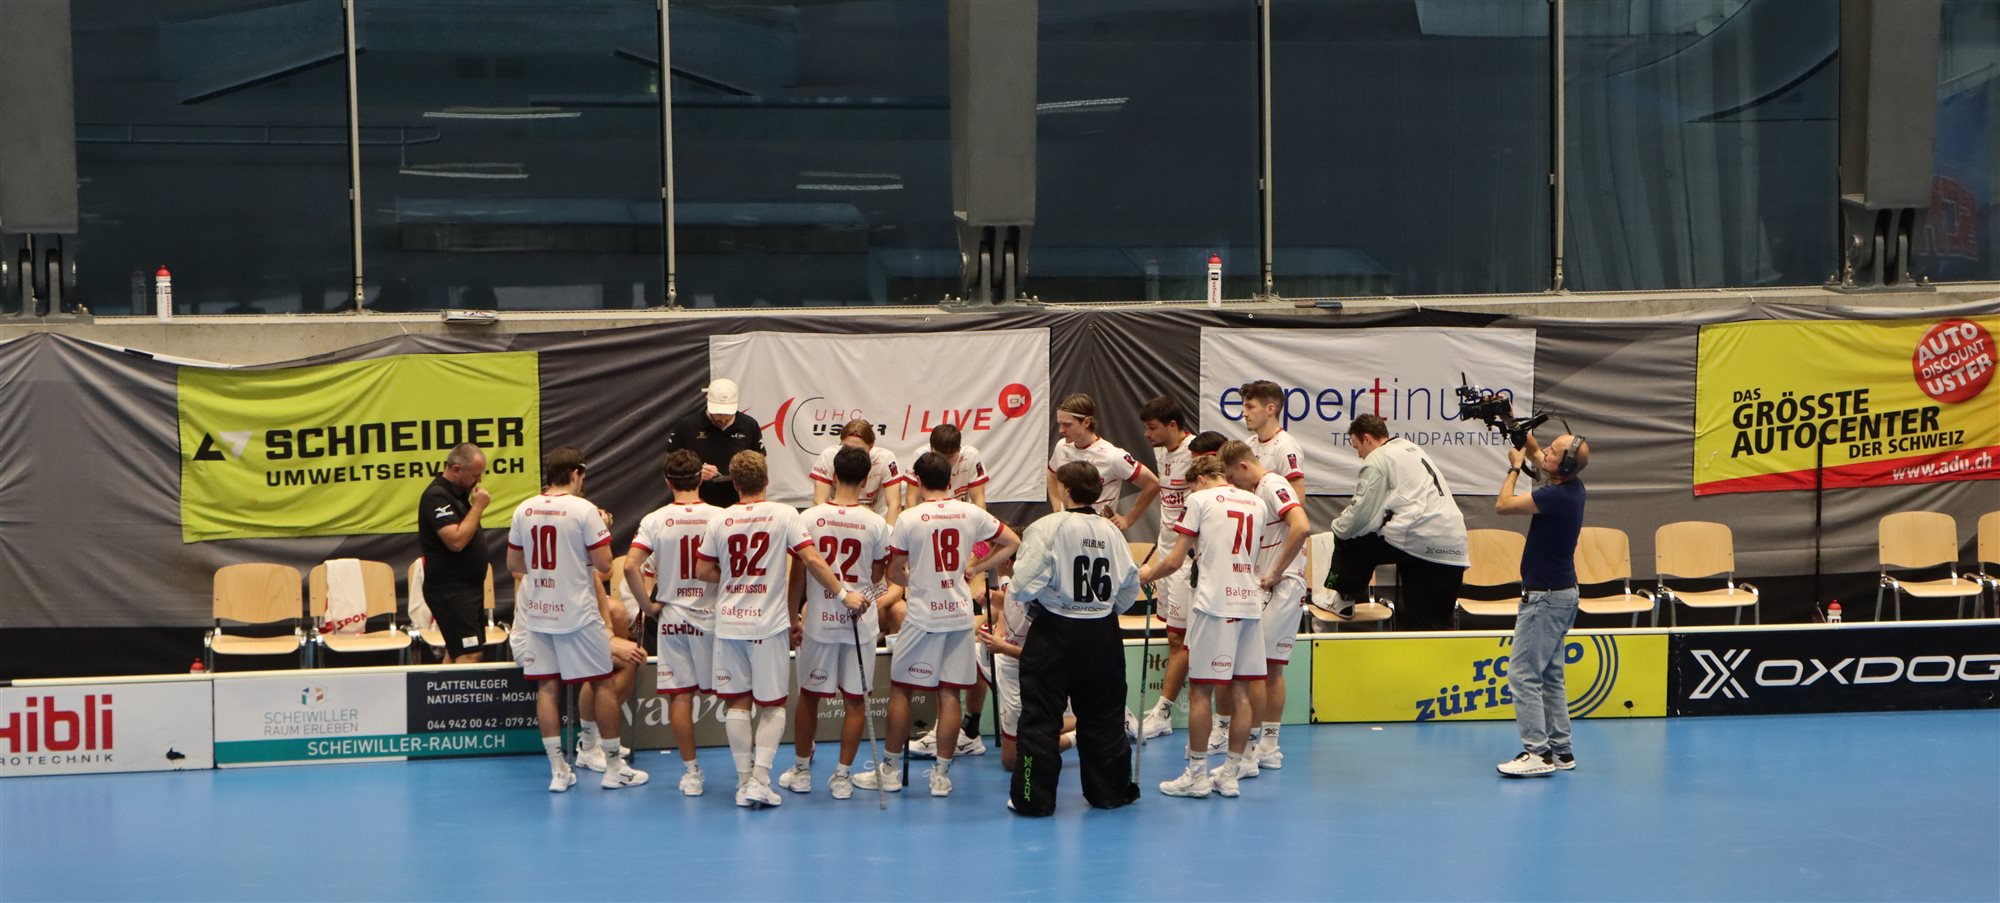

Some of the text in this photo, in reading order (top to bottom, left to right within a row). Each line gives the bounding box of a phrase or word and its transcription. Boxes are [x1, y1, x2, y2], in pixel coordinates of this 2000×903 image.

[1918, 322, 1980, 367] AUTO
[1921, 338, 1985, 379] DISCOUNT
[1925, 352, 1995, 396] USTER
[1219, 377, 1514, 432] epertinu
[1732, 388, 1870, 430] GRÖSSTE
[1733, 388, 1762, 404] DAS
[812, 423, 887, 436] USR
[814, 407, 994, 433] UHC LIVE
[1730, 405, 1941, 458] AUTOCENTER
[265, 416, 525, 460] SCHNEIDER
[1848, 429, 1965, 460] DER SCHWEIZ
[266, 457, 525, 488] UMWELTSERV.CH
[1892, 452, 1993, 481] www.adu.ch
[530, 525, 557, 570] 10
[1226, 509, 1254, 557] 71
[727, 531, 770, 578] 82
[819, 535, 862, 584] 22
[931, 528, 960, 573] 18
[677, 587, 704, 598] PFISTER
[1073, 555, 1112, 603] 66
[1225, 586, 1258, 599] Balgris
[528, 600, 565, 613] Balgrist
[721, 606, 763, 618] Balgrist
[822, 611, 863, 624] Balgrt
[930, 599, 969, 613] Balgrst
[426, 679, 509, 691] PLATTENLEGER
[1755, 654, 2000, 687] OXDOG
[426, 693, 493, 705] NATURSTEIN
[264, 708, 359, 725] SCHEIWILLER
[264, 722, 359, 737] RAUM ERLEBEN
[427, 720, 446, 730] 044
[448, 719, 467, 729] 942
[469, 718, 482, 728] 00
[484, 718, 497, 728] 42
[505, 717, 524, 727] 079
[526, 716, 539, 726] 24
[307, 734, 506, 757] SCHEIWILLER-RAUM.CH
